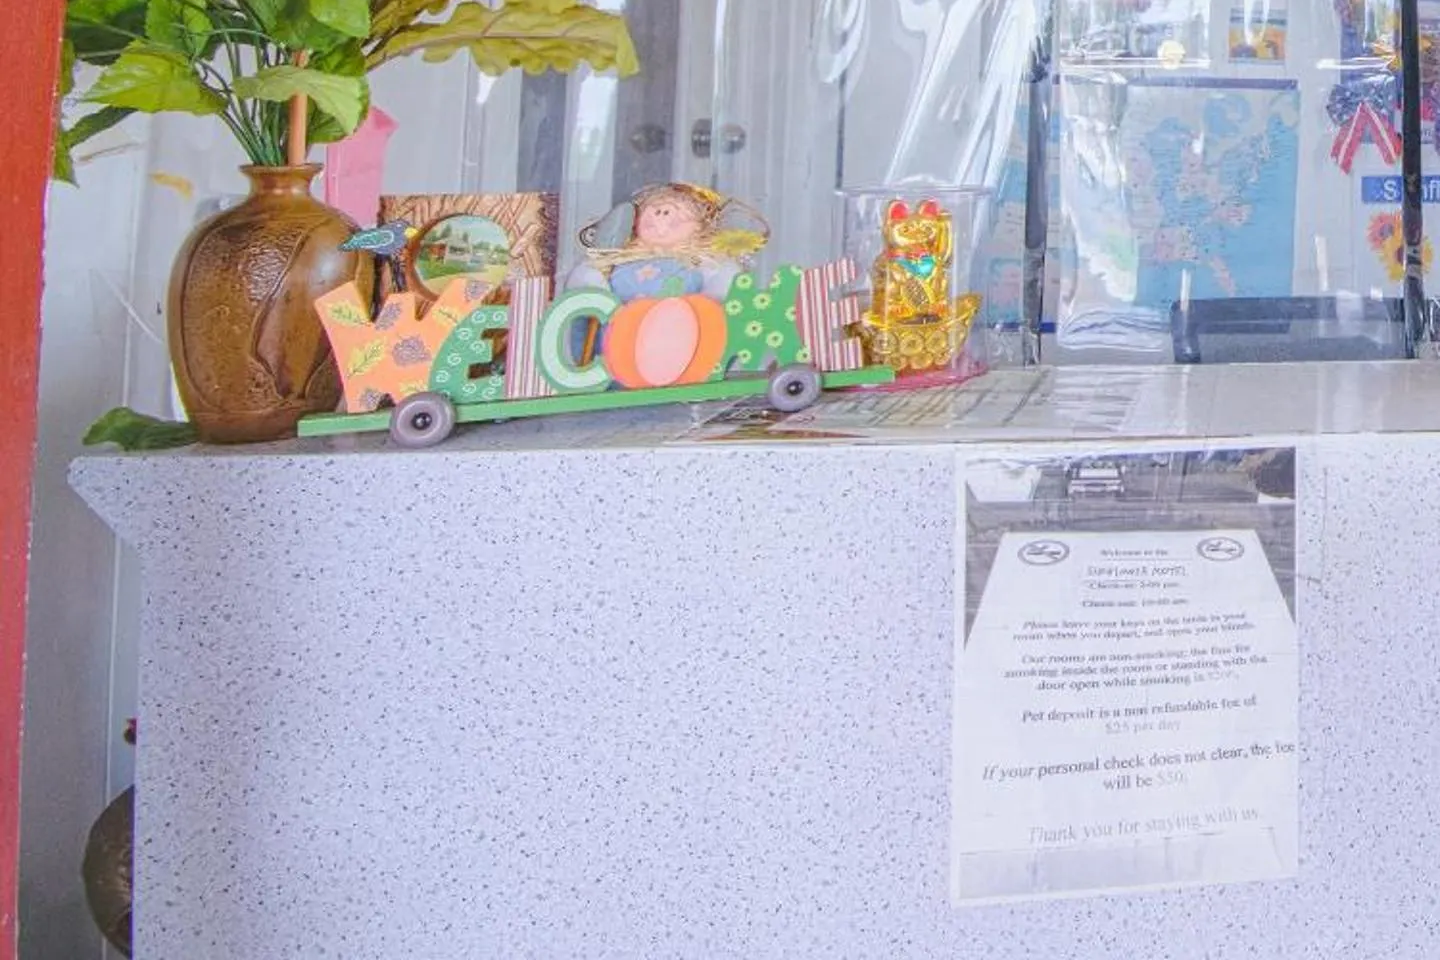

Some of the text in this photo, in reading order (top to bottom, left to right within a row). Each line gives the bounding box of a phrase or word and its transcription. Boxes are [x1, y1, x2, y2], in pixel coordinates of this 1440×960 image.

[1094, 620, 1118, 629] your
[1120, 617, 1146, 629] keys
[1003, 668, 1059, 680] smoking
[1061, 665, 1098, 676] inside
[1100, 664, 1119, 675] the
[1122, 663, 1153, 673] room
[1155, 662, 1169, 672] or
[1170, 659, 1221, 673] standing
[1222, 656, 1248, 667] with
[1048, 654, 1086, 664] rooms
[1036, 679, 1067, 691] door
[1068, 680, 1100, 692] open
[1103, 675, 1138, 688] while
[1139, 674, 1192, 688] smoking
[1021, 708, 1044, 724] Pet
[1047, 707, 1095, 724] deposit
[1099, 706, 1111, 719] is
[1124, 706, 1149, 719] non
[1151, 699, 1219, 716] refundable
[1221, 696, 1241, 710] fee
[1243, 694, 1258, 708] of
[981, 740, 1295, 783] If your personal check does not clear, the fee
[1103, 776, 1132, 792] will
[1135, 773, 1153, 789] be
[1027, 822, 1079, 846] Thank
[1082, 824, 1114, 843] you
[1117, 818, 1142, 838] for
[1145, 813, 1200, 837] staying
[1204, 806, 1238, 826] with
